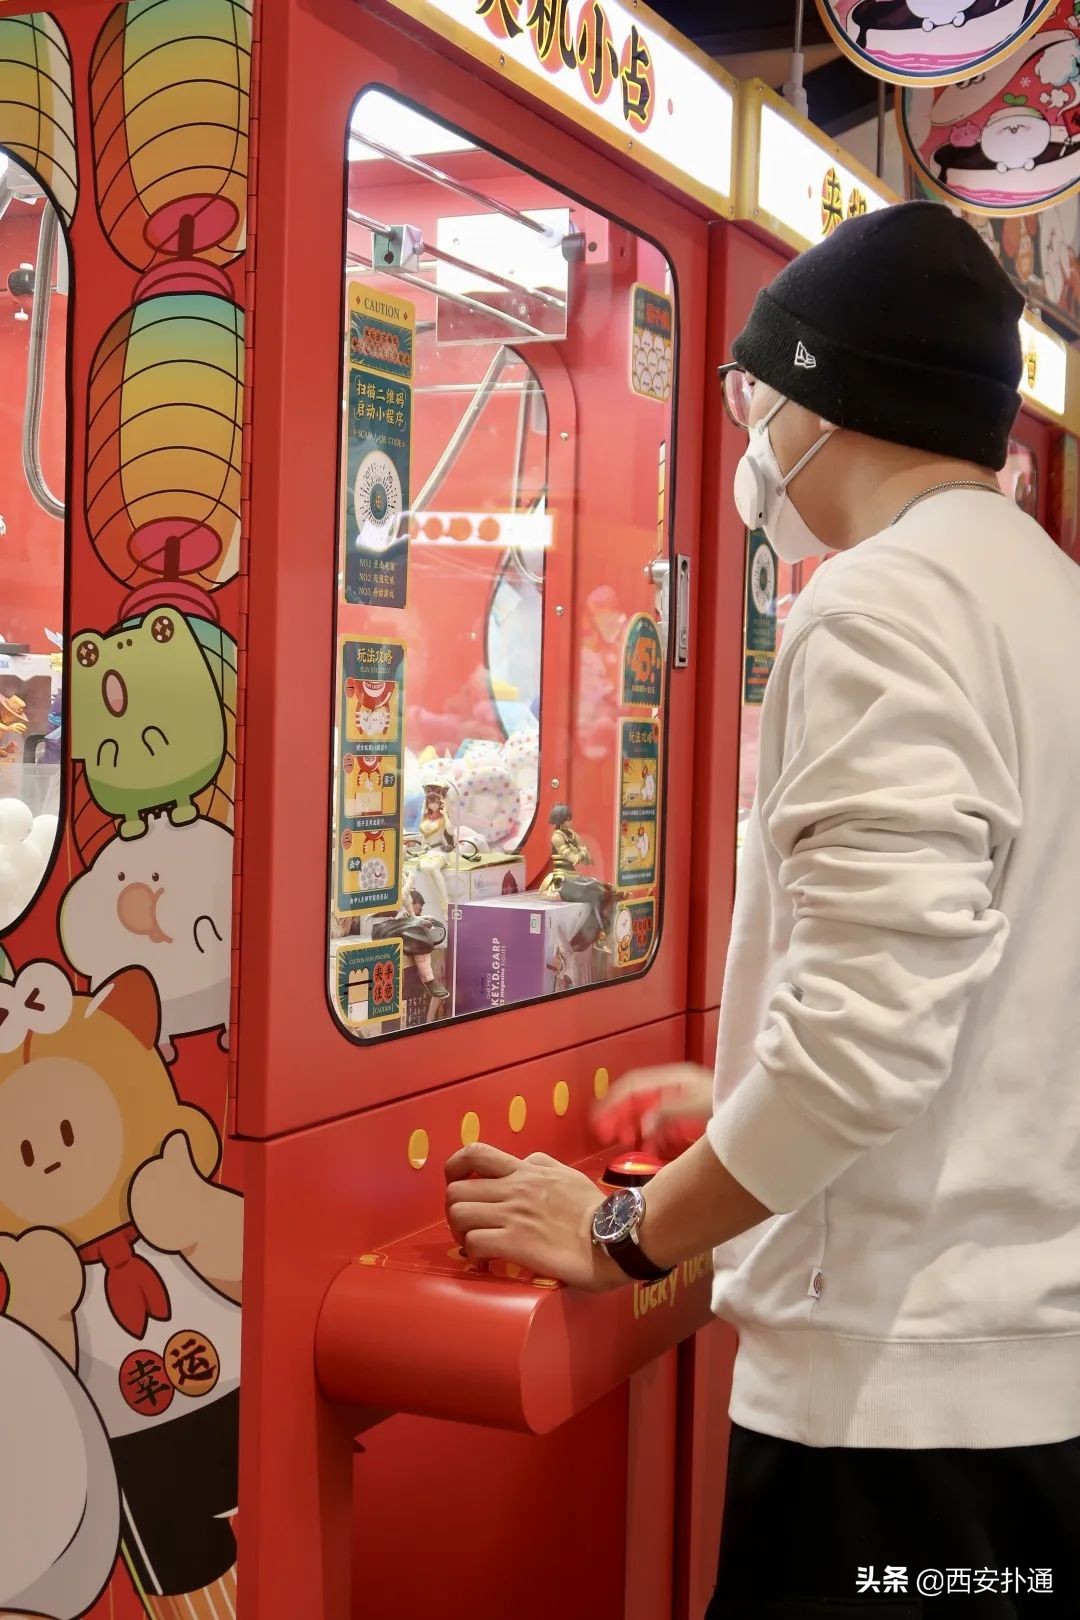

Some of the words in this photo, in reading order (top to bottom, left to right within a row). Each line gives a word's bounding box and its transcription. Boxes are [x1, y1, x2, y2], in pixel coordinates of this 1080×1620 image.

[364, 297, 400, 320] CAUTION
[356, 380, 405, 409] 扫描二维码
[356, 400, 404, 427] 启动小程序
[357, 648, 393, 664] 玩法攻略
